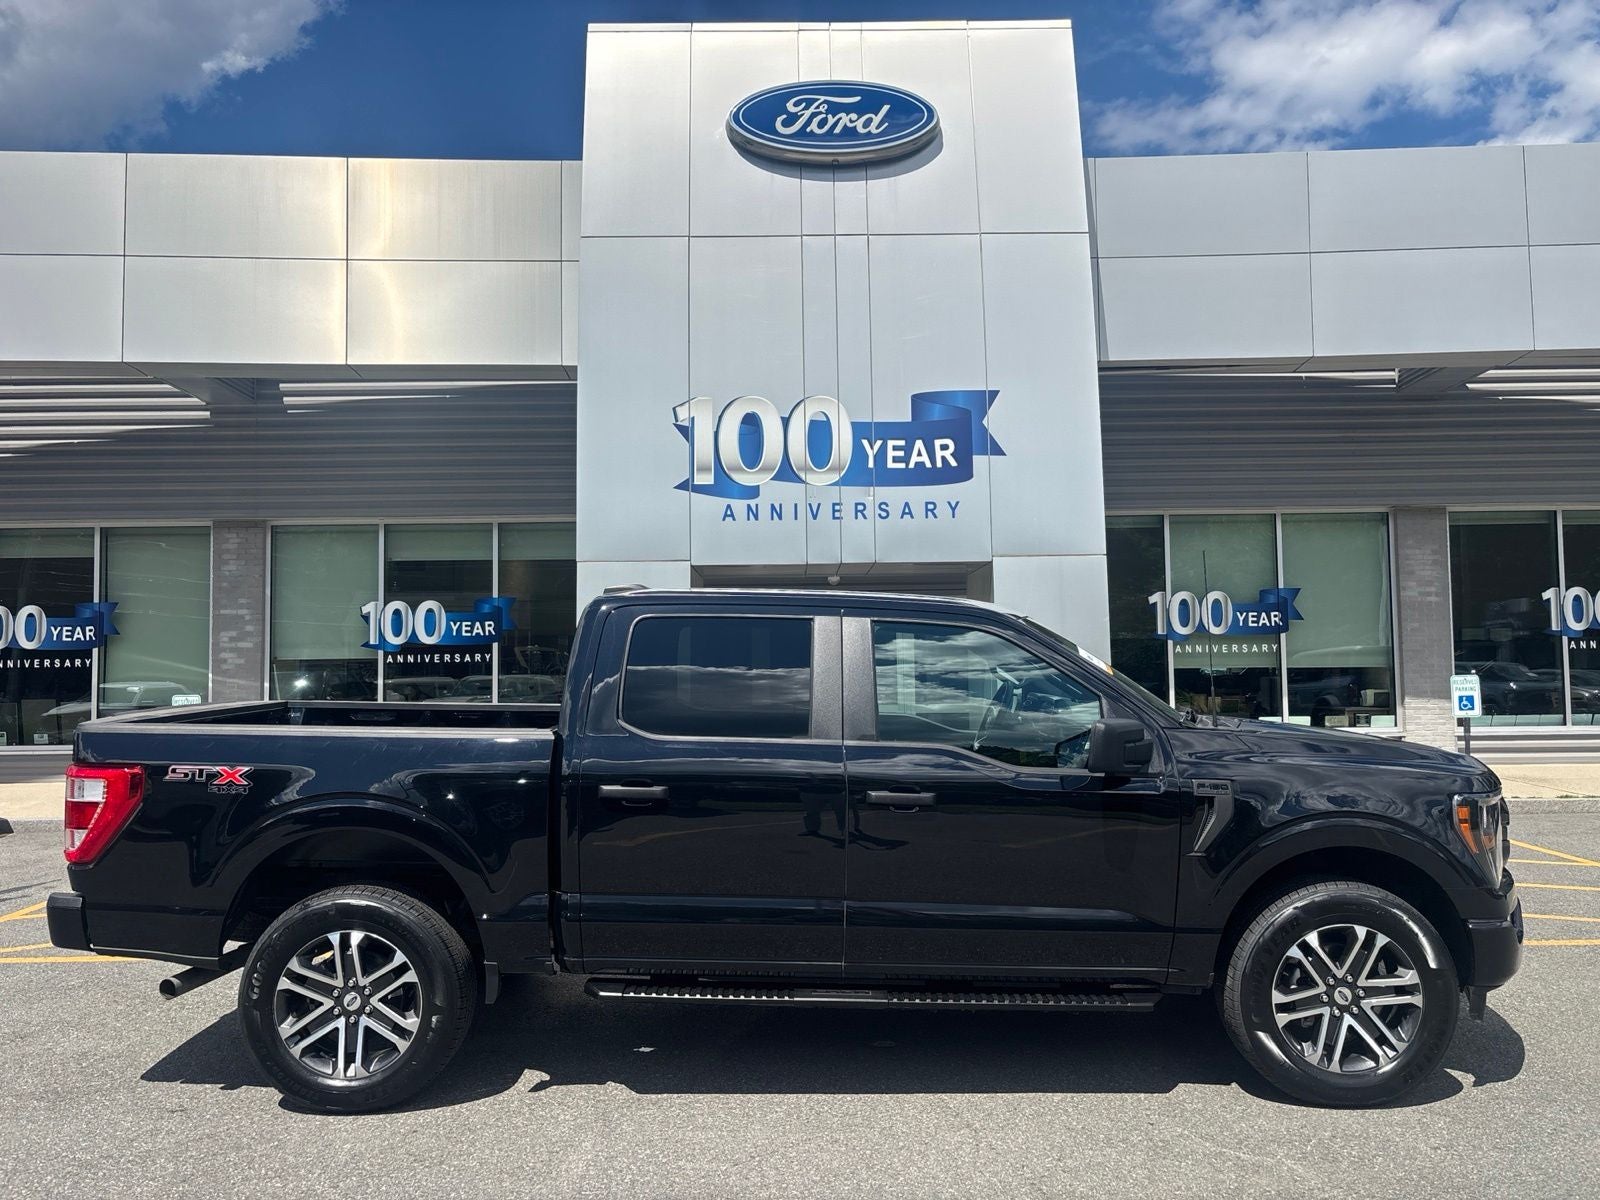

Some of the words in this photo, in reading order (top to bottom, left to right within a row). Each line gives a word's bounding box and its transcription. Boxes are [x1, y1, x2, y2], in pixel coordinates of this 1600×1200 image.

[775, 94, 891, 135] Ford
[673, 395, 854, 486] 100
[861, 438, 959, 470] YEAR
[721, 500, 961, 522] ANNIVERSARY
[360, 600, 447, 645] 100
[450, 620, 496, 637] YEAR
[1147, 590, 1233, 635] 100
[1236, 611, 1283, 627] YEAR
[1541, 586, 1600, 631] 10
[50, 625, 96, 641] YEAR
[1174, 643, 1278, 654] ANNIVERSARY
[386, 653, 491, 664] ANNIVERSARY
[163, 765, 254, 786] STX
